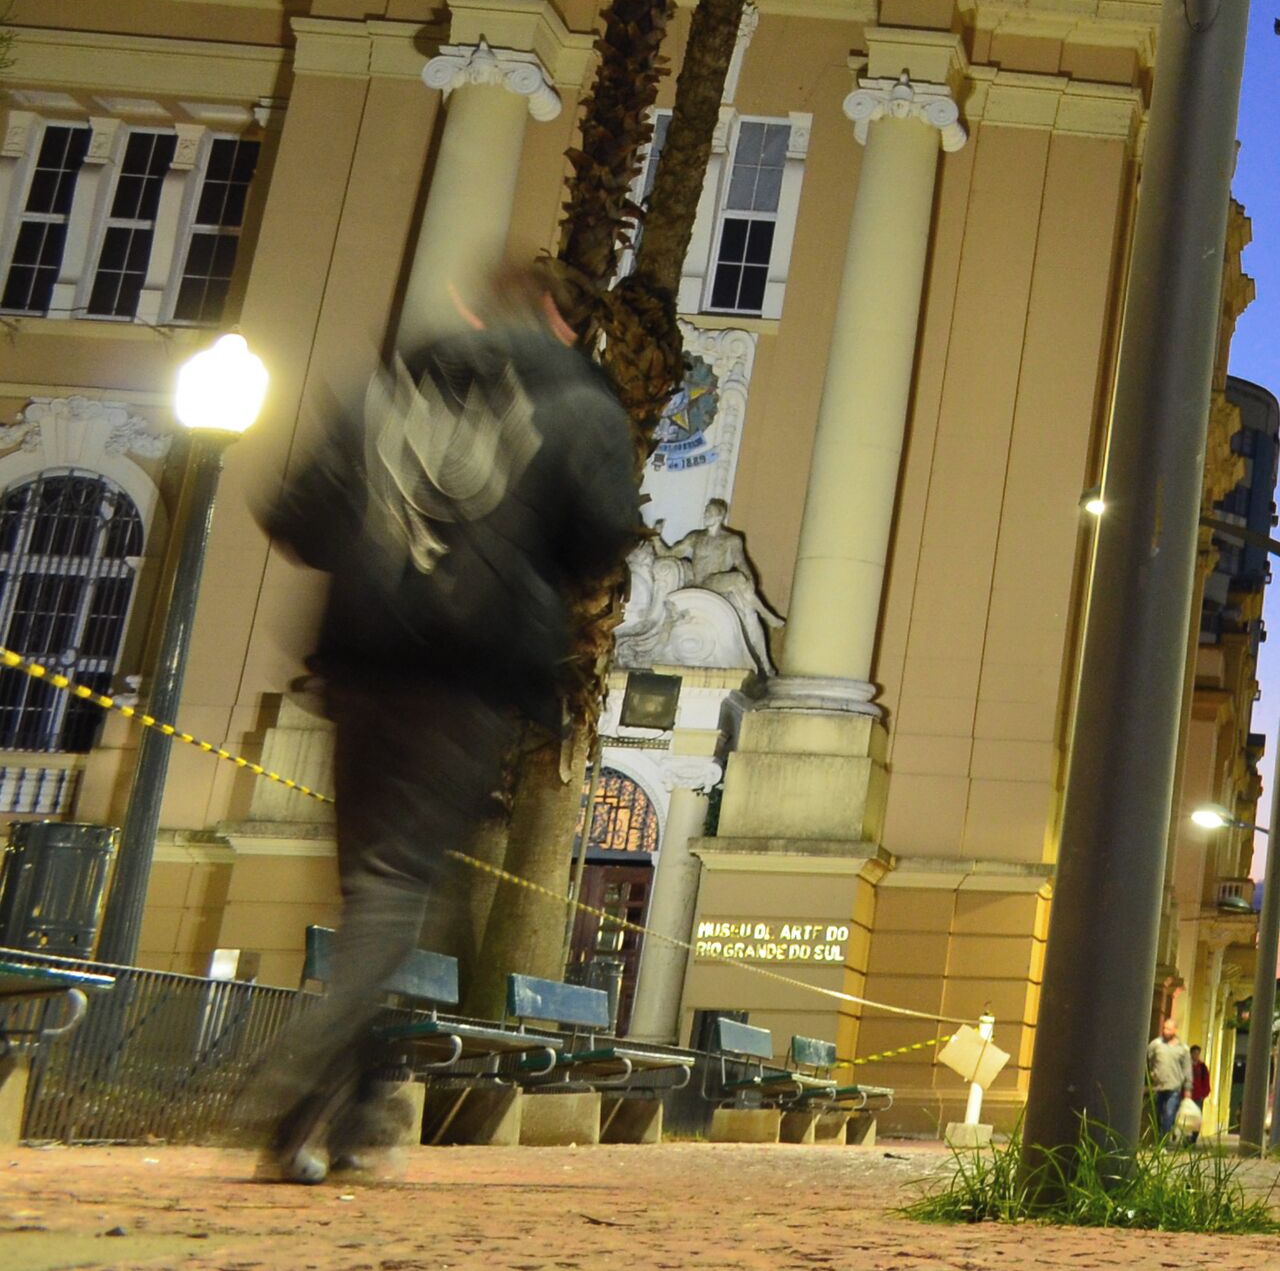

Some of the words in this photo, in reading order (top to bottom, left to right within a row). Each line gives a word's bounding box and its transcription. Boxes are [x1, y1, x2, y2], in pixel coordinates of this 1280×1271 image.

[827, 926, 849, 942] DO
[696, 941, 722, 957] RIO
[724, 942, 787, 960] GRANDE
[789, 944, 811, 960] DO
[814, 945, 845, 961] SUL
